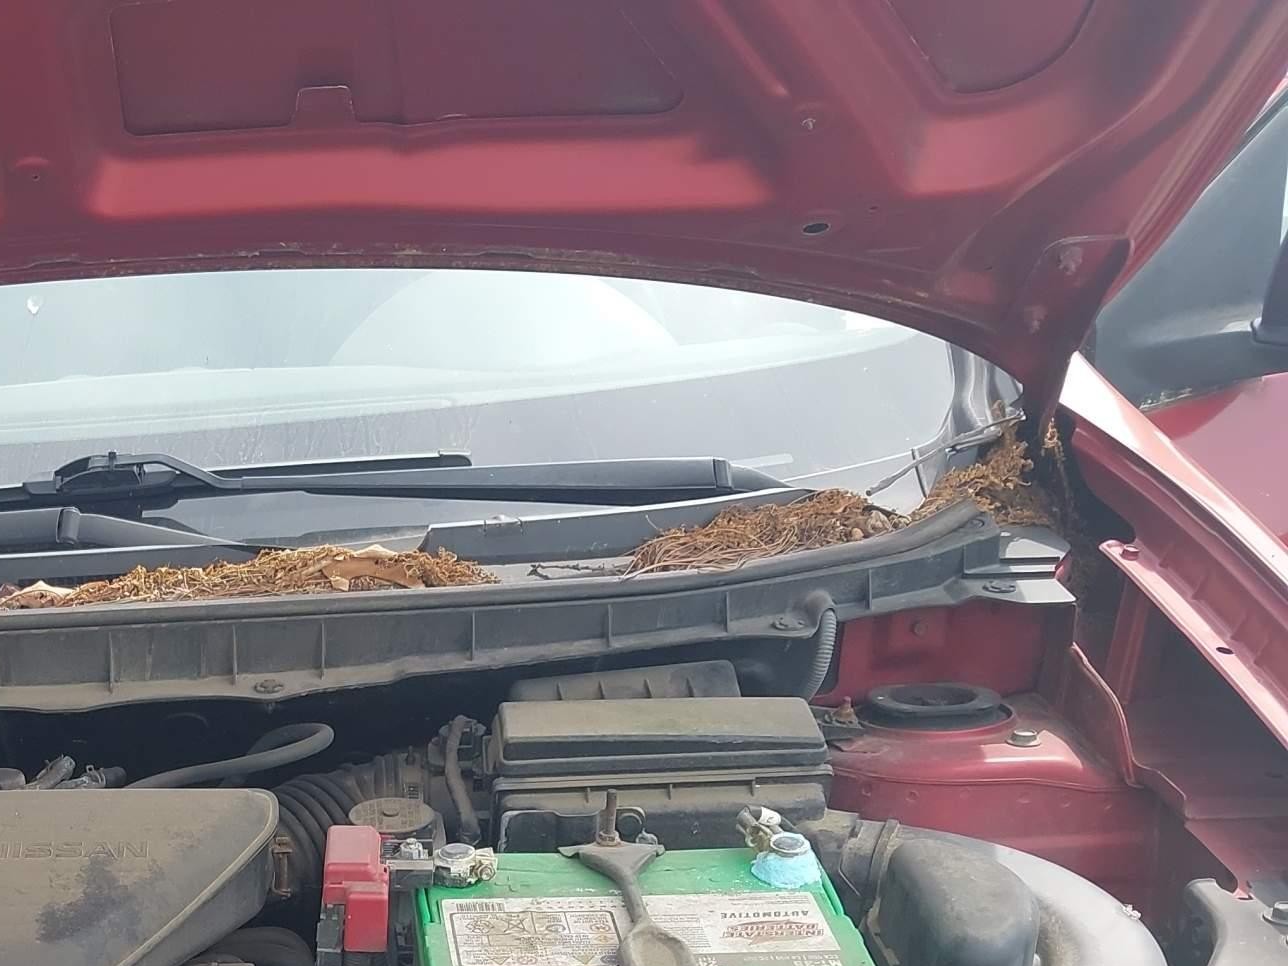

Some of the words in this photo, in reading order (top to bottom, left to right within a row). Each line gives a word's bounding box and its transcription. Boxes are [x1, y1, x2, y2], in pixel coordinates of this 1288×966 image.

[720, 910, 810, 919] AUTOMOTIVE
[726, 923, 819, 932] BATTERIES
[722, 929, 825, 938] INTERSTATE
